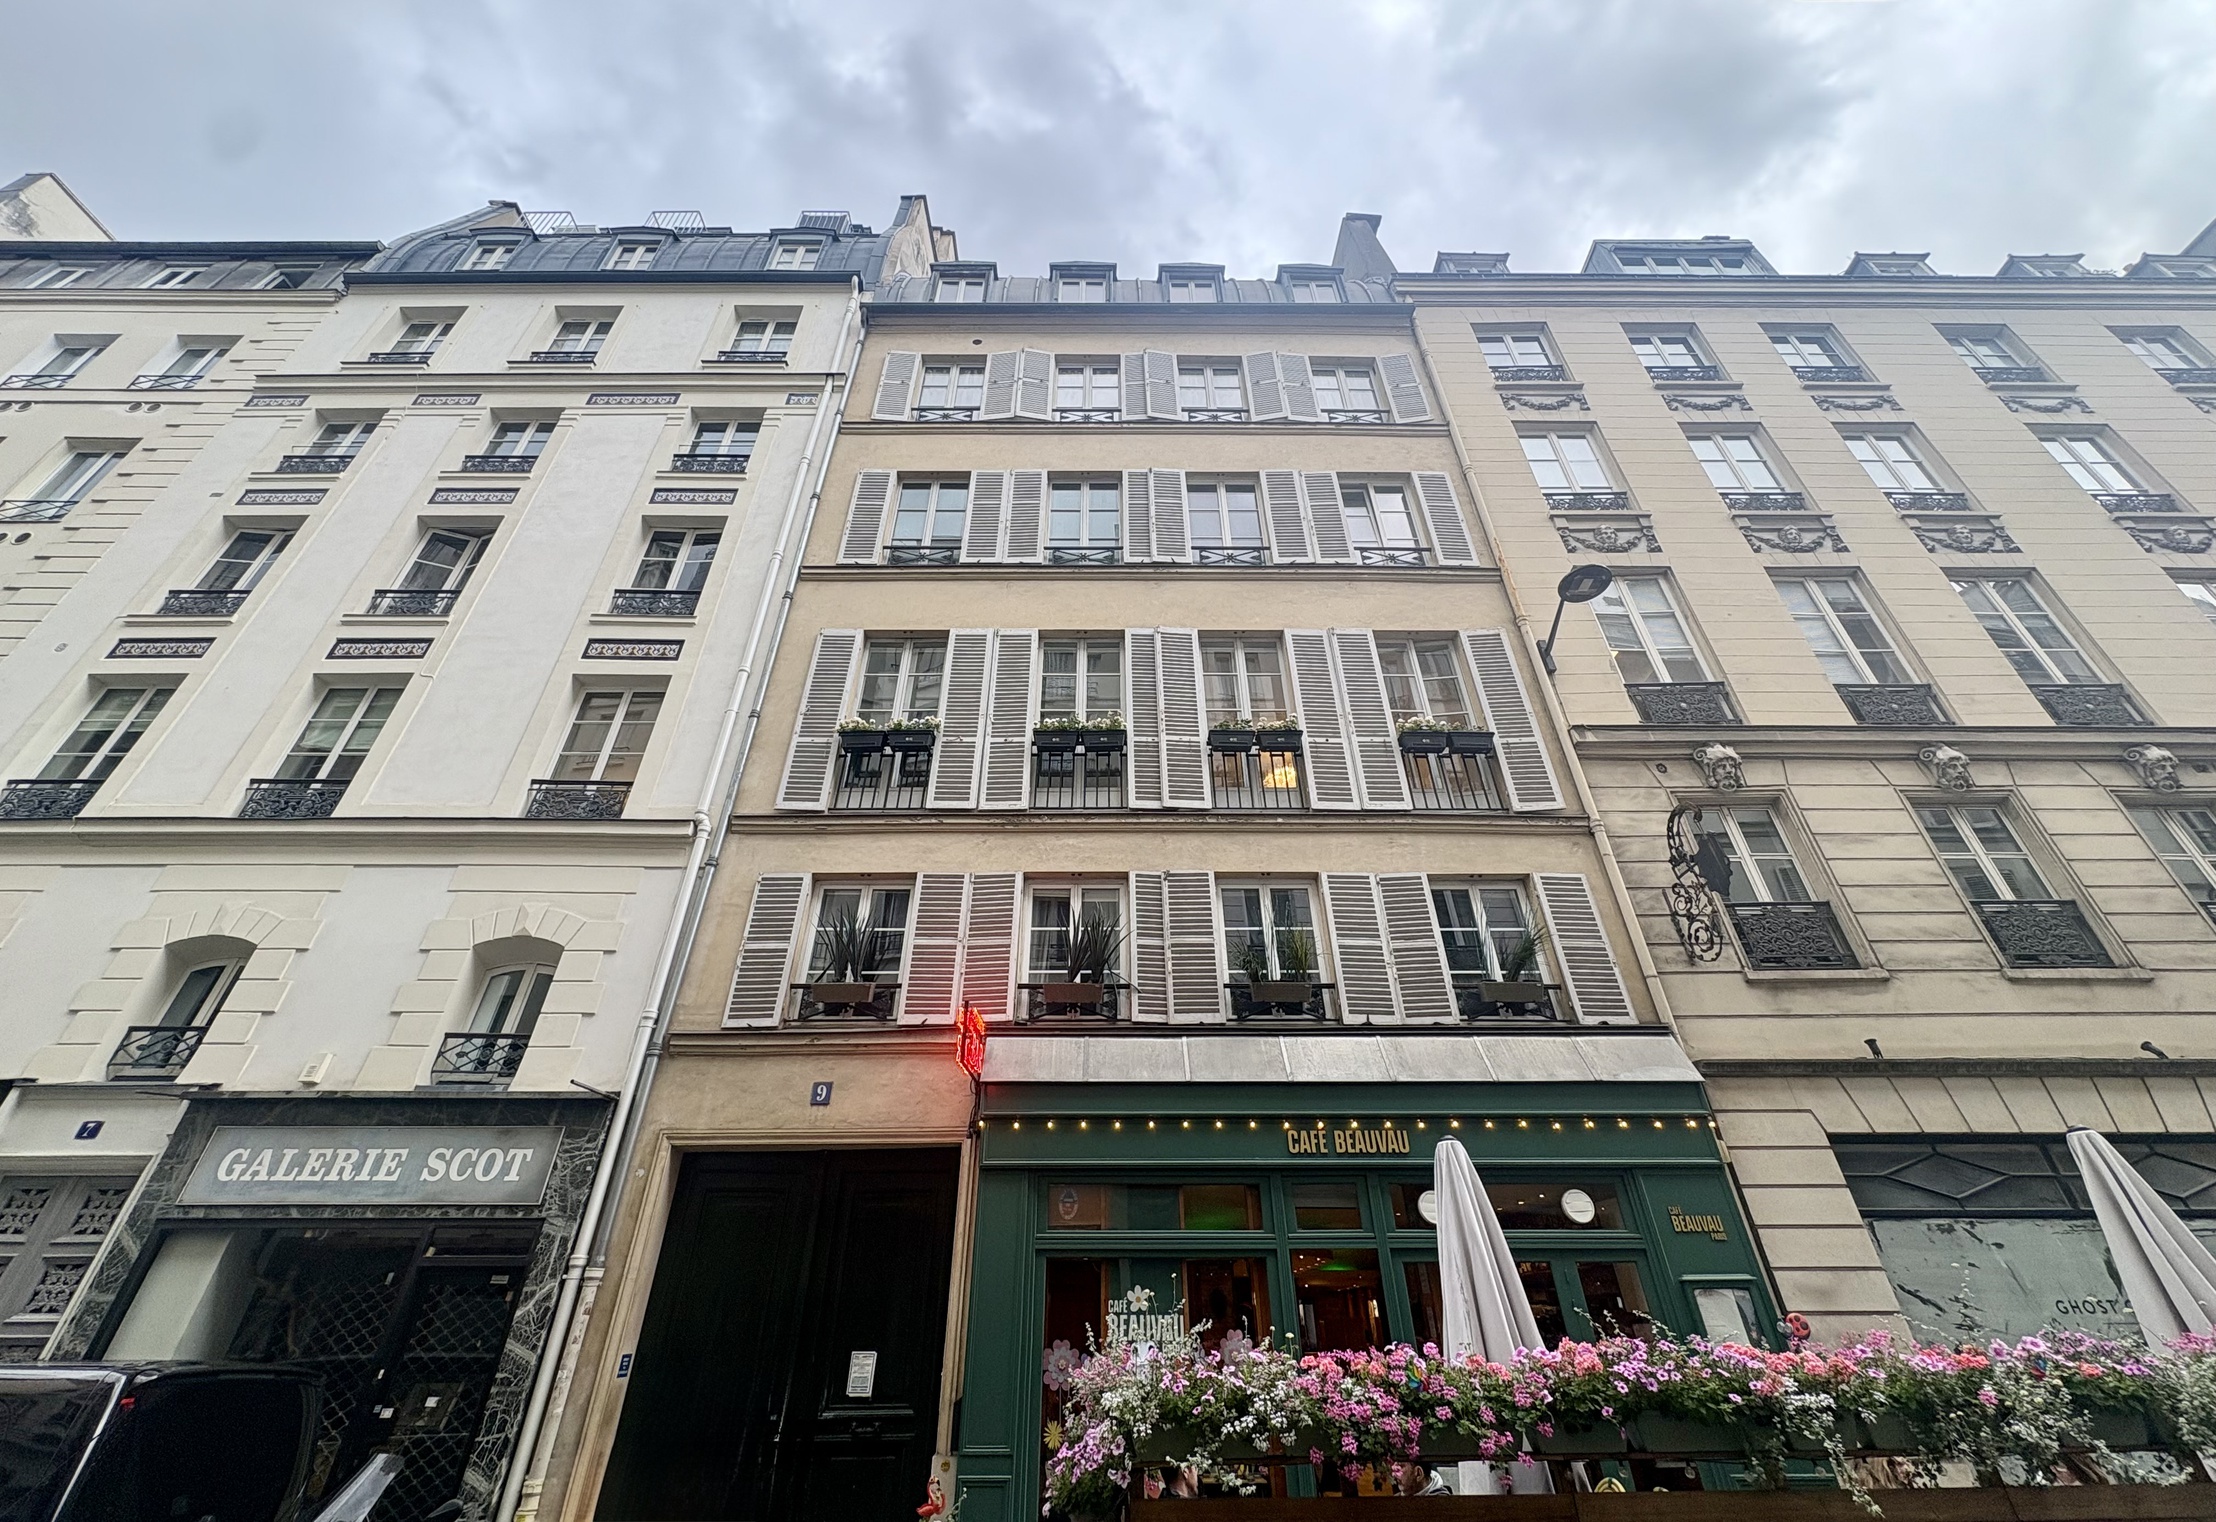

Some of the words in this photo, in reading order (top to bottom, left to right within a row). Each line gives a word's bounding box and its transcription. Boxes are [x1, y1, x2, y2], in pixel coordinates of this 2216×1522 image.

[816, 1084, 827, 1102] 9
[81, 1122, 97, 1137] 7
[1333, 1129, 1410, 1154] BEAUVAU
[216, 1147, 409, 1182] GALERIE
[419, 1147, 534, 1182] SCOT
[1671, 1215, 1724, 1232] BEAUVAU
[1108, 1296, 1128, 1313] CAFÉ
[2055, 1299, 2119, 1315] GHOST
[1107, 1314, 1185, 1342] BEAUVAU
